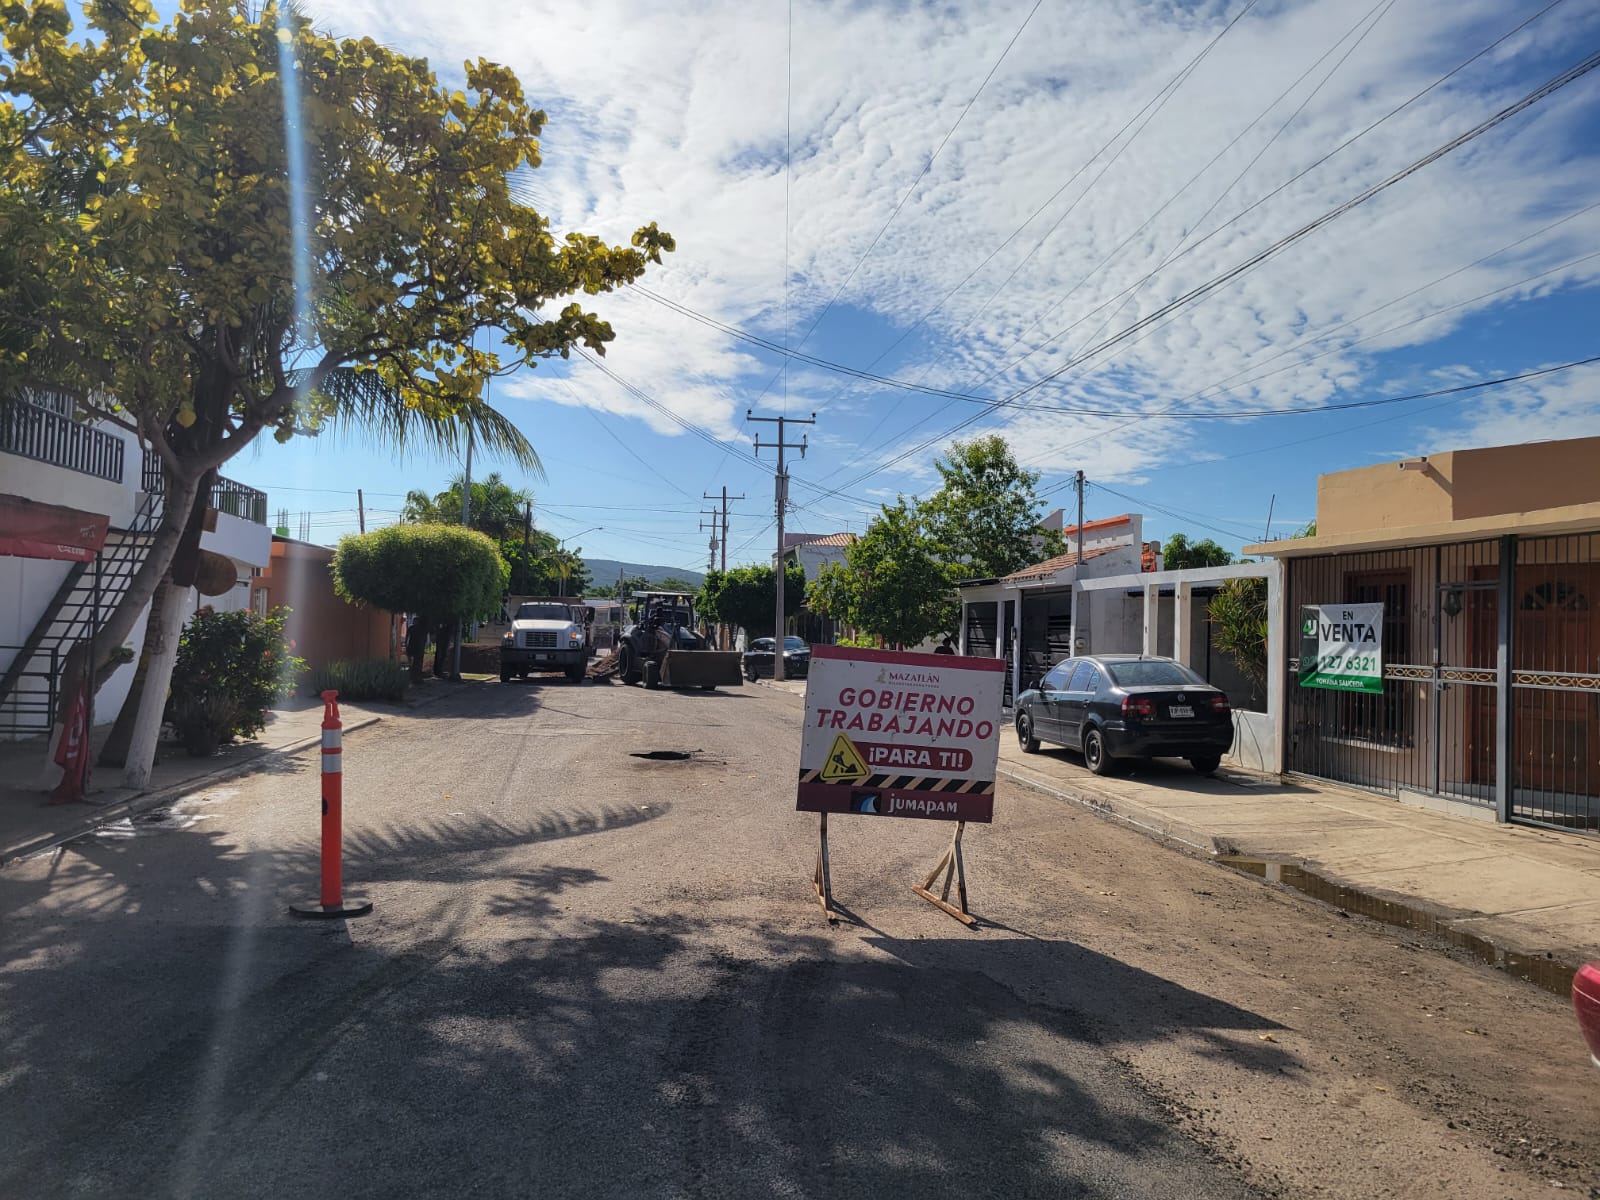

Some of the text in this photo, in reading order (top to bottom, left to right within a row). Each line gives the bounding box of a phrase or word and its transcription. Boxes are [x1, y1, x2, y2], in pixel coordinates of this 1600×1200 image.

[1342, 610, 1354, 620] EN
[1321, 623, 1377, 643] VENTA
[1345, 656, 1376, 672] 6321
[888, 671, 940, 683] MAZATLÁN
[839, 687, 975, 716] GOBIERNO
[816, 708, 993, 740] TRABAJANDO
[938, 751, 964, 768] TI!
